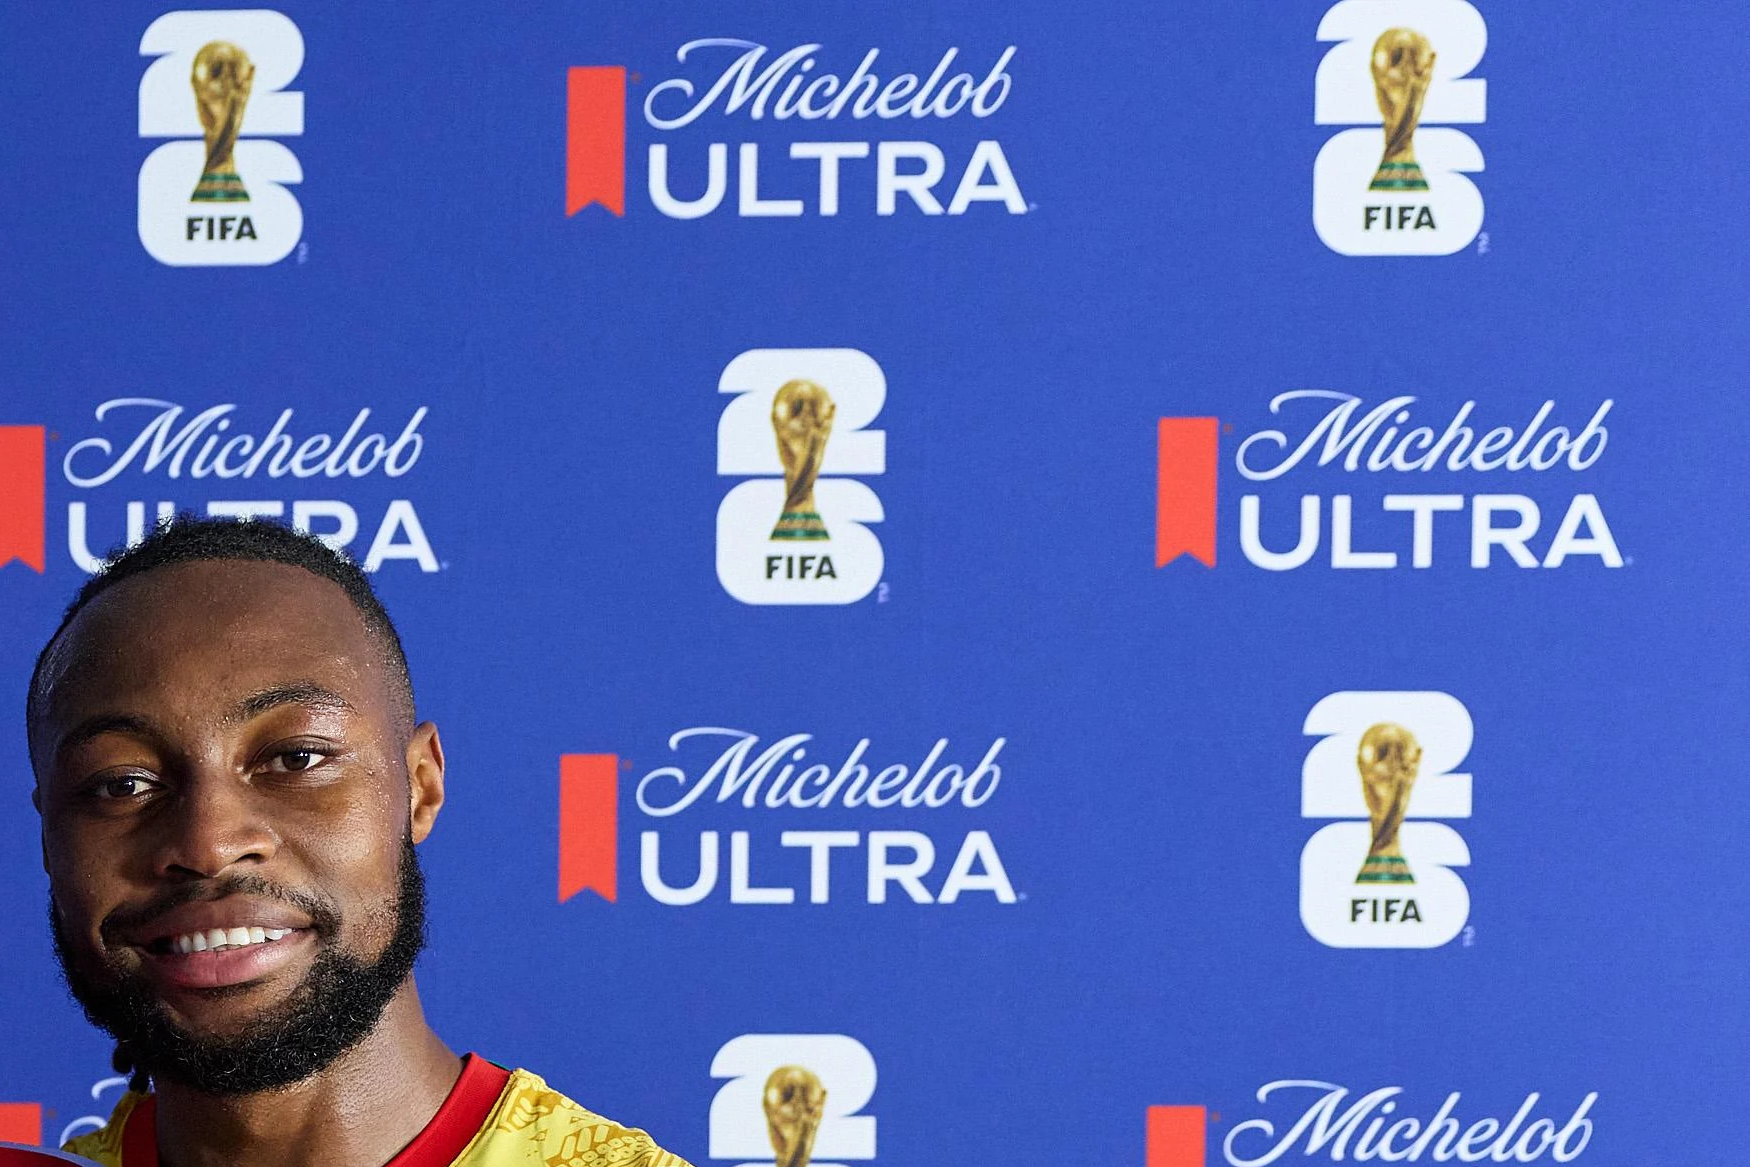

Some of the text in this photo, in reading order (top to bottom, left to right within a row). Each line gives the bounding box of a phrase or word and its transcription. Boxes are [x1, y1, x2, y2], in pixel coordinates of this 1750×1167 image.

[644, 39, 1016, 129] Michelob
[649, 141, 1028, 219] ULTRA
[186, 215, 259, 241] FIFA
[1364, 205, 1437, 231] FIFA
[63, 397, 428, 488] Michelob
[1236, 390, 1613, 480] Michelob
[68, 500, 439, 573] URA
[766, 554, 838, 580] FIFA
[1240, 494, 1623, 570] ULTRA
[636, 727, 1005, 816] Michelob
[641, 831, 1016, 905] ULTRA
[1351, 897, 1424, 923] FIFA
